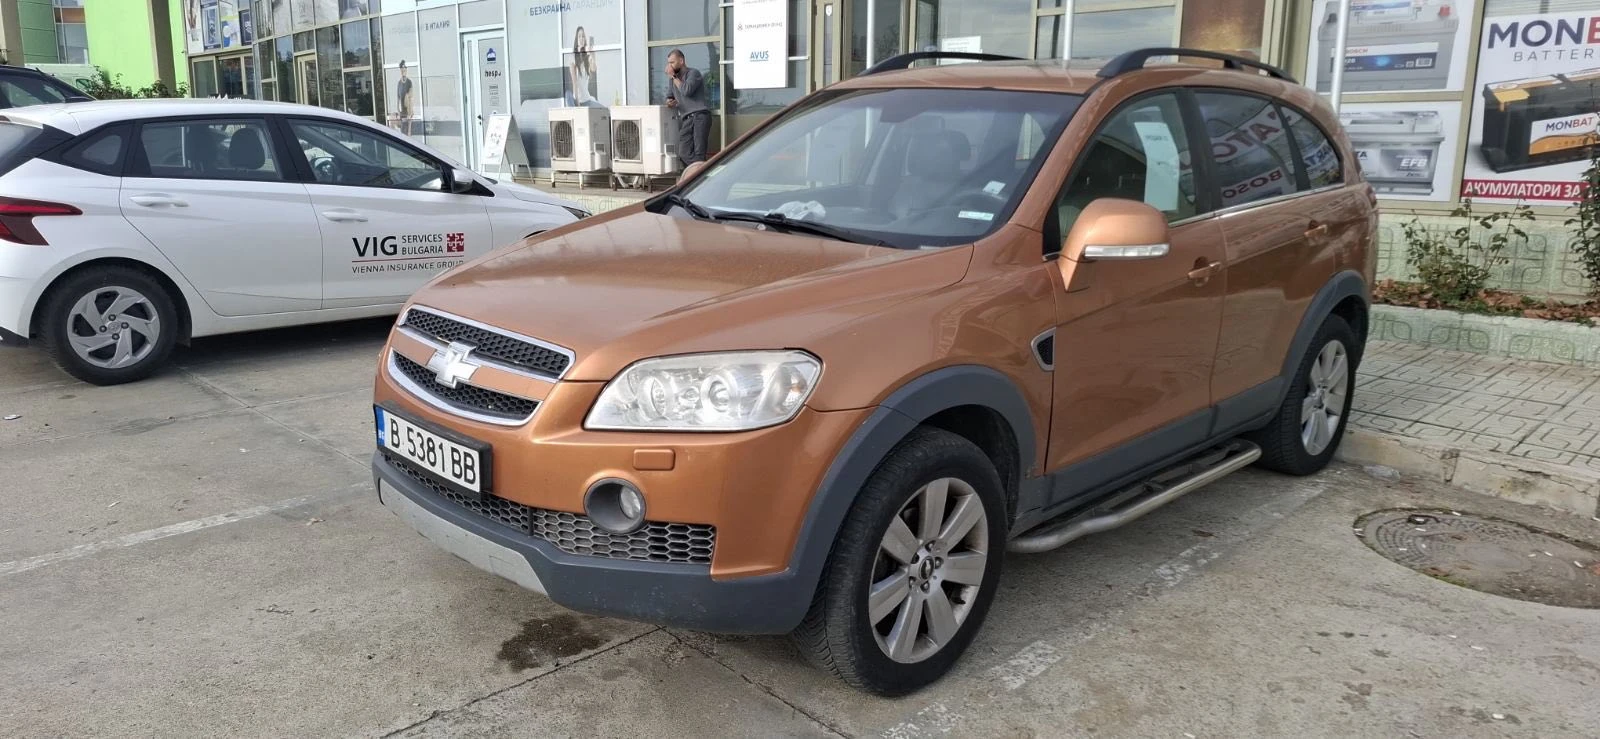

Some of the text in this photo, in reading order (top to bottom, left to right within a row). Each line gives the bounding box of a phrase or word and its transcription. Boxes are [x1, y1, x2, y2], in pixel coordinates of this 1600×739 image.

[750, 50, 769, 60] AVUS
[1546, 117, 1594, 132] MONBAT
[1400, 158, 1428, 167] EFB
[1464, 182, 1561, 197] АКУМУЛАТОРИ
[352, 233, 443, 257] VIG SERVICES
[401, 245, 444, 255] BULGARIA
[352, 265, 385, 274] VIENNA
[387, 262, 434, 272] INSURANCE
[390, 418, 476, 484] B 5381 BB
